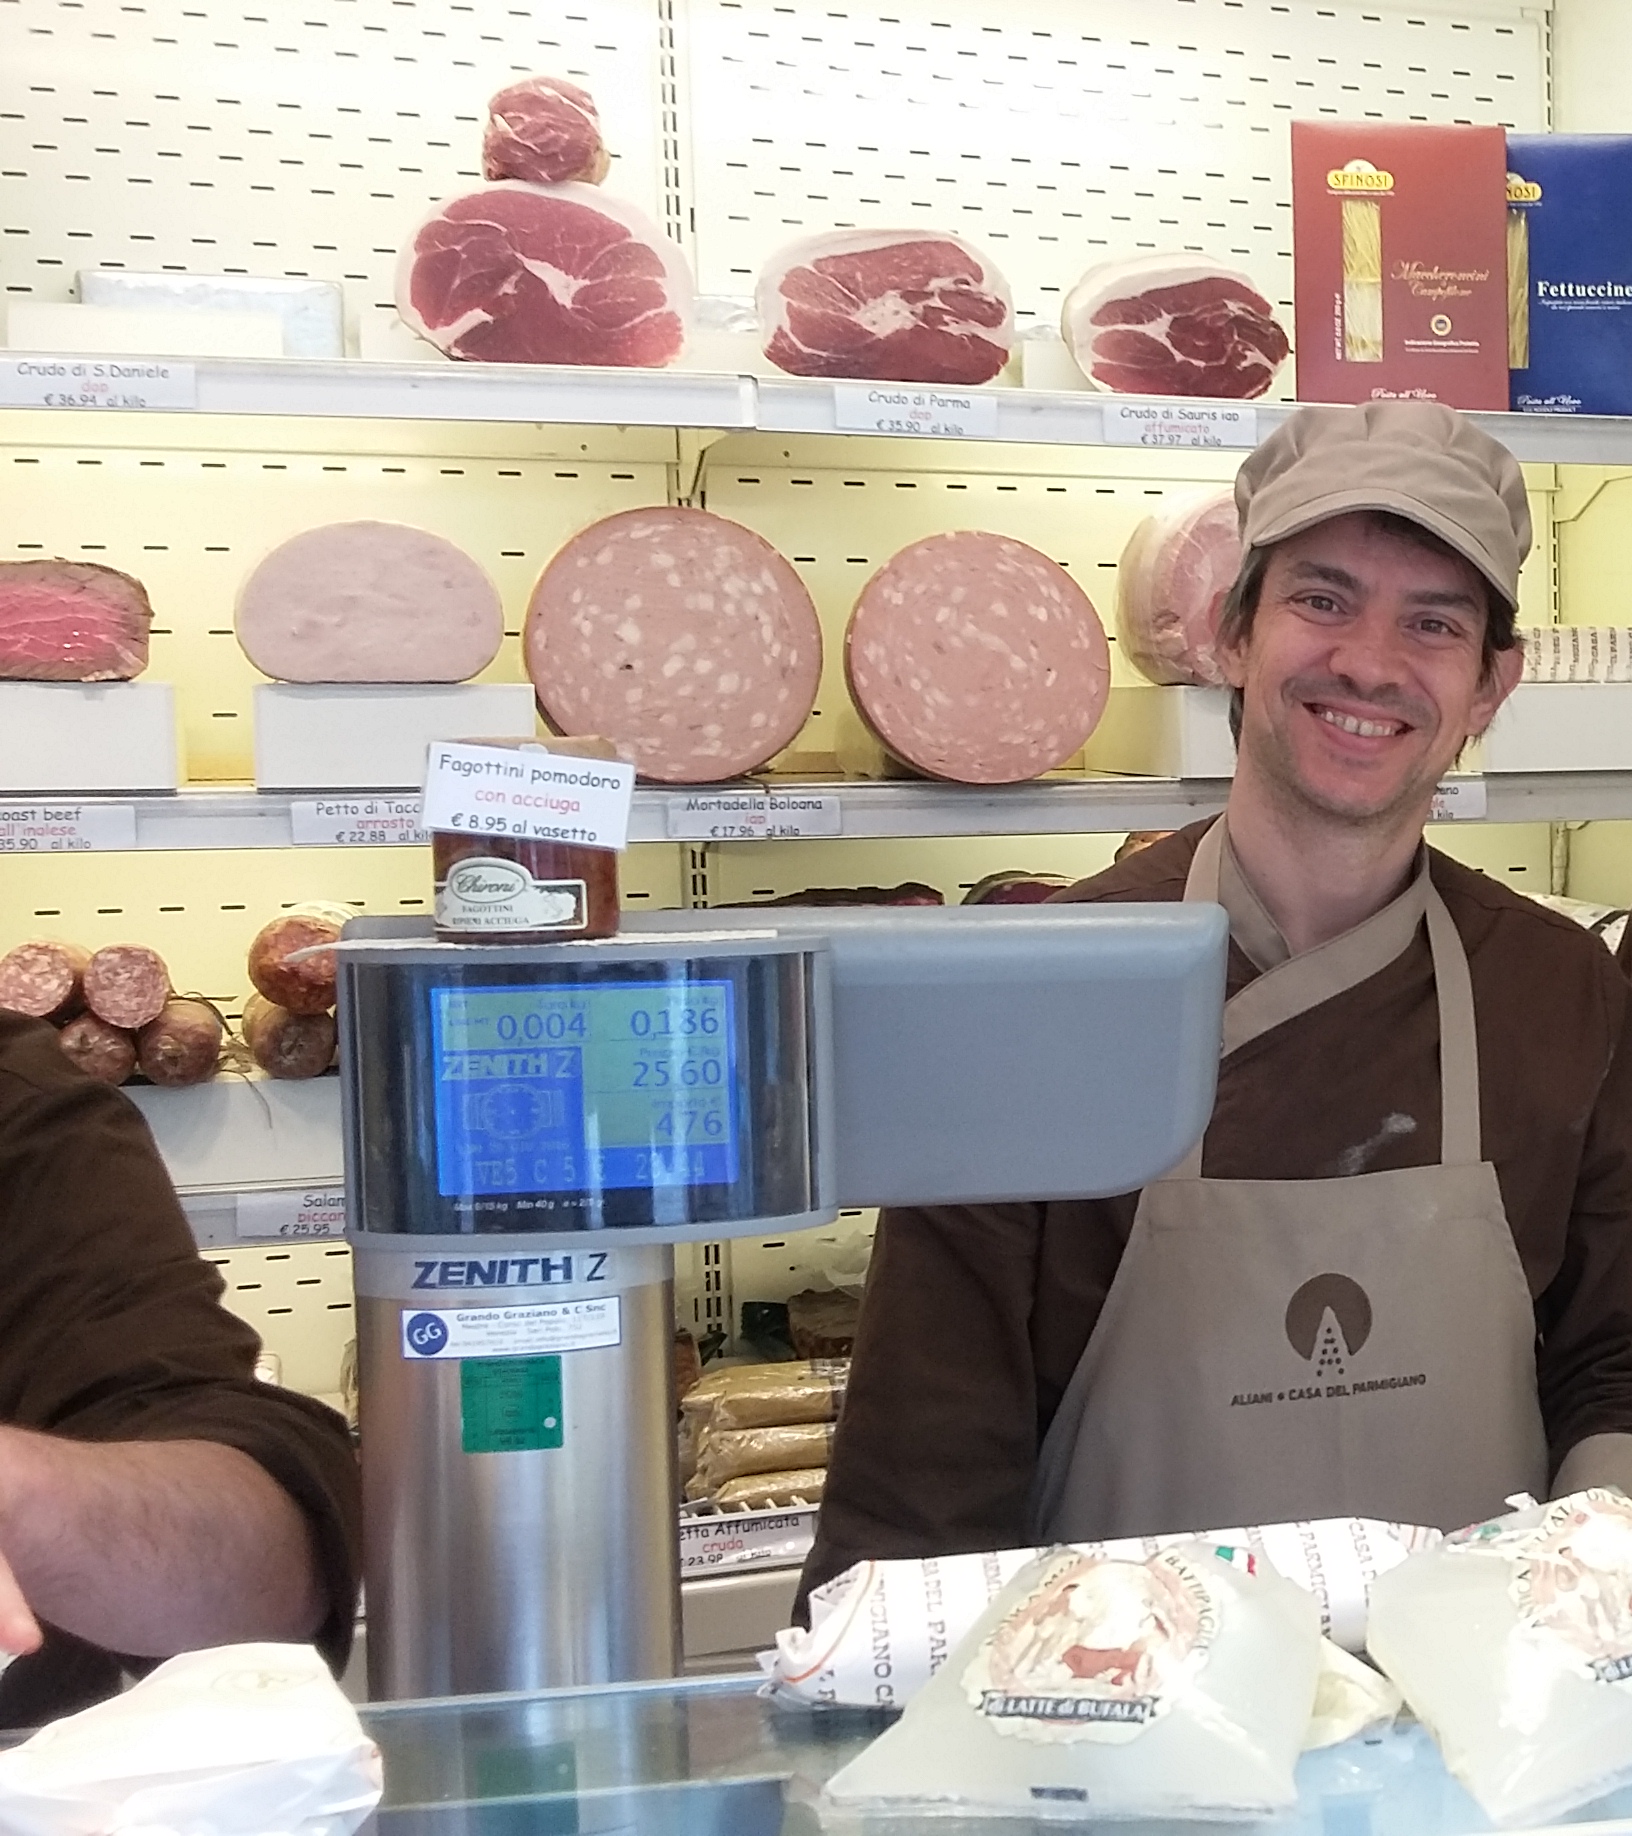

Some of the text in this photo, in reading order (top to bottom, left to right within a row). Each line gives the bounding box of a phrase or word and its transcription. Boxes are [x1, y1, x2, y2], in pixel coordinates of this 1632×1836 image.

[1334, 173, 1388, 188] SPINOSI
[17, 362, 67, 377] Crudo
[72, 362, 87, 377] di
[44, 393, 54, 406] €
[106, 395, 119, 407] al
[123, 395, 147, 408] kilo
[868, 390, 971, 410] Crudo di Parma
[1120, 407, 1218, 421] Crudo di Sauris
[876, 419, 886, 431] €
[931, 422, 941, 435] al
[943, 423, 964, 436] kilo
[1144, 421, 1210, 434] affumicato
[1140, 434, 1149, 445] €
[1191, 435, 1200, 447] al
[1203, 436, 1222, 447] kilo
[439, 754, 621, 790] Fagottini pomodoro
[316, 801, 359, 816] Petto
[364, 800, 378, 815] di
[475, 788, 581, 815] con acciuga
[686, 797, 765, 812] Mortadella
[44, 806, 82, 822] beef
[356, 816, 415, 830] arrosto
[451, 812, 598, 843] € 8.95 al vasetto
[710, 825, 720, 837] €
[765, 825, 776, 837] al
[780, 825, 801, 837] kilo
[51, 838, 91, 850] al kilo
[335, 831, 346, 843] €
[398, 829, 410, 841] al
[461, 904, 514, 914] FAGOTTINI
[496, 1012, 587, 1046] 0,004
[442, 1050, 576, 1081] ZENITH Z
[280, 1223, 330, 1235] € 25.95
[412, 1252, 608, 1290] ZENITH Z
[456, 1304, 606, 1323] Grando Graziano & Snc
[412, 1321, 442, 1346] GG
[1230, 1373, 1427, 1407] ALIANI CASA DEL PARMIGIANO
[715, 1517, 800, 1536] Affumicata
[1348, 1521, 1373, 1565] CASA
[1007, 1698, 1055, 1715] LATTE
[1056, 1699, 1076, 1715] di
[1076, 1700, 1147, 1720] BUFALA
